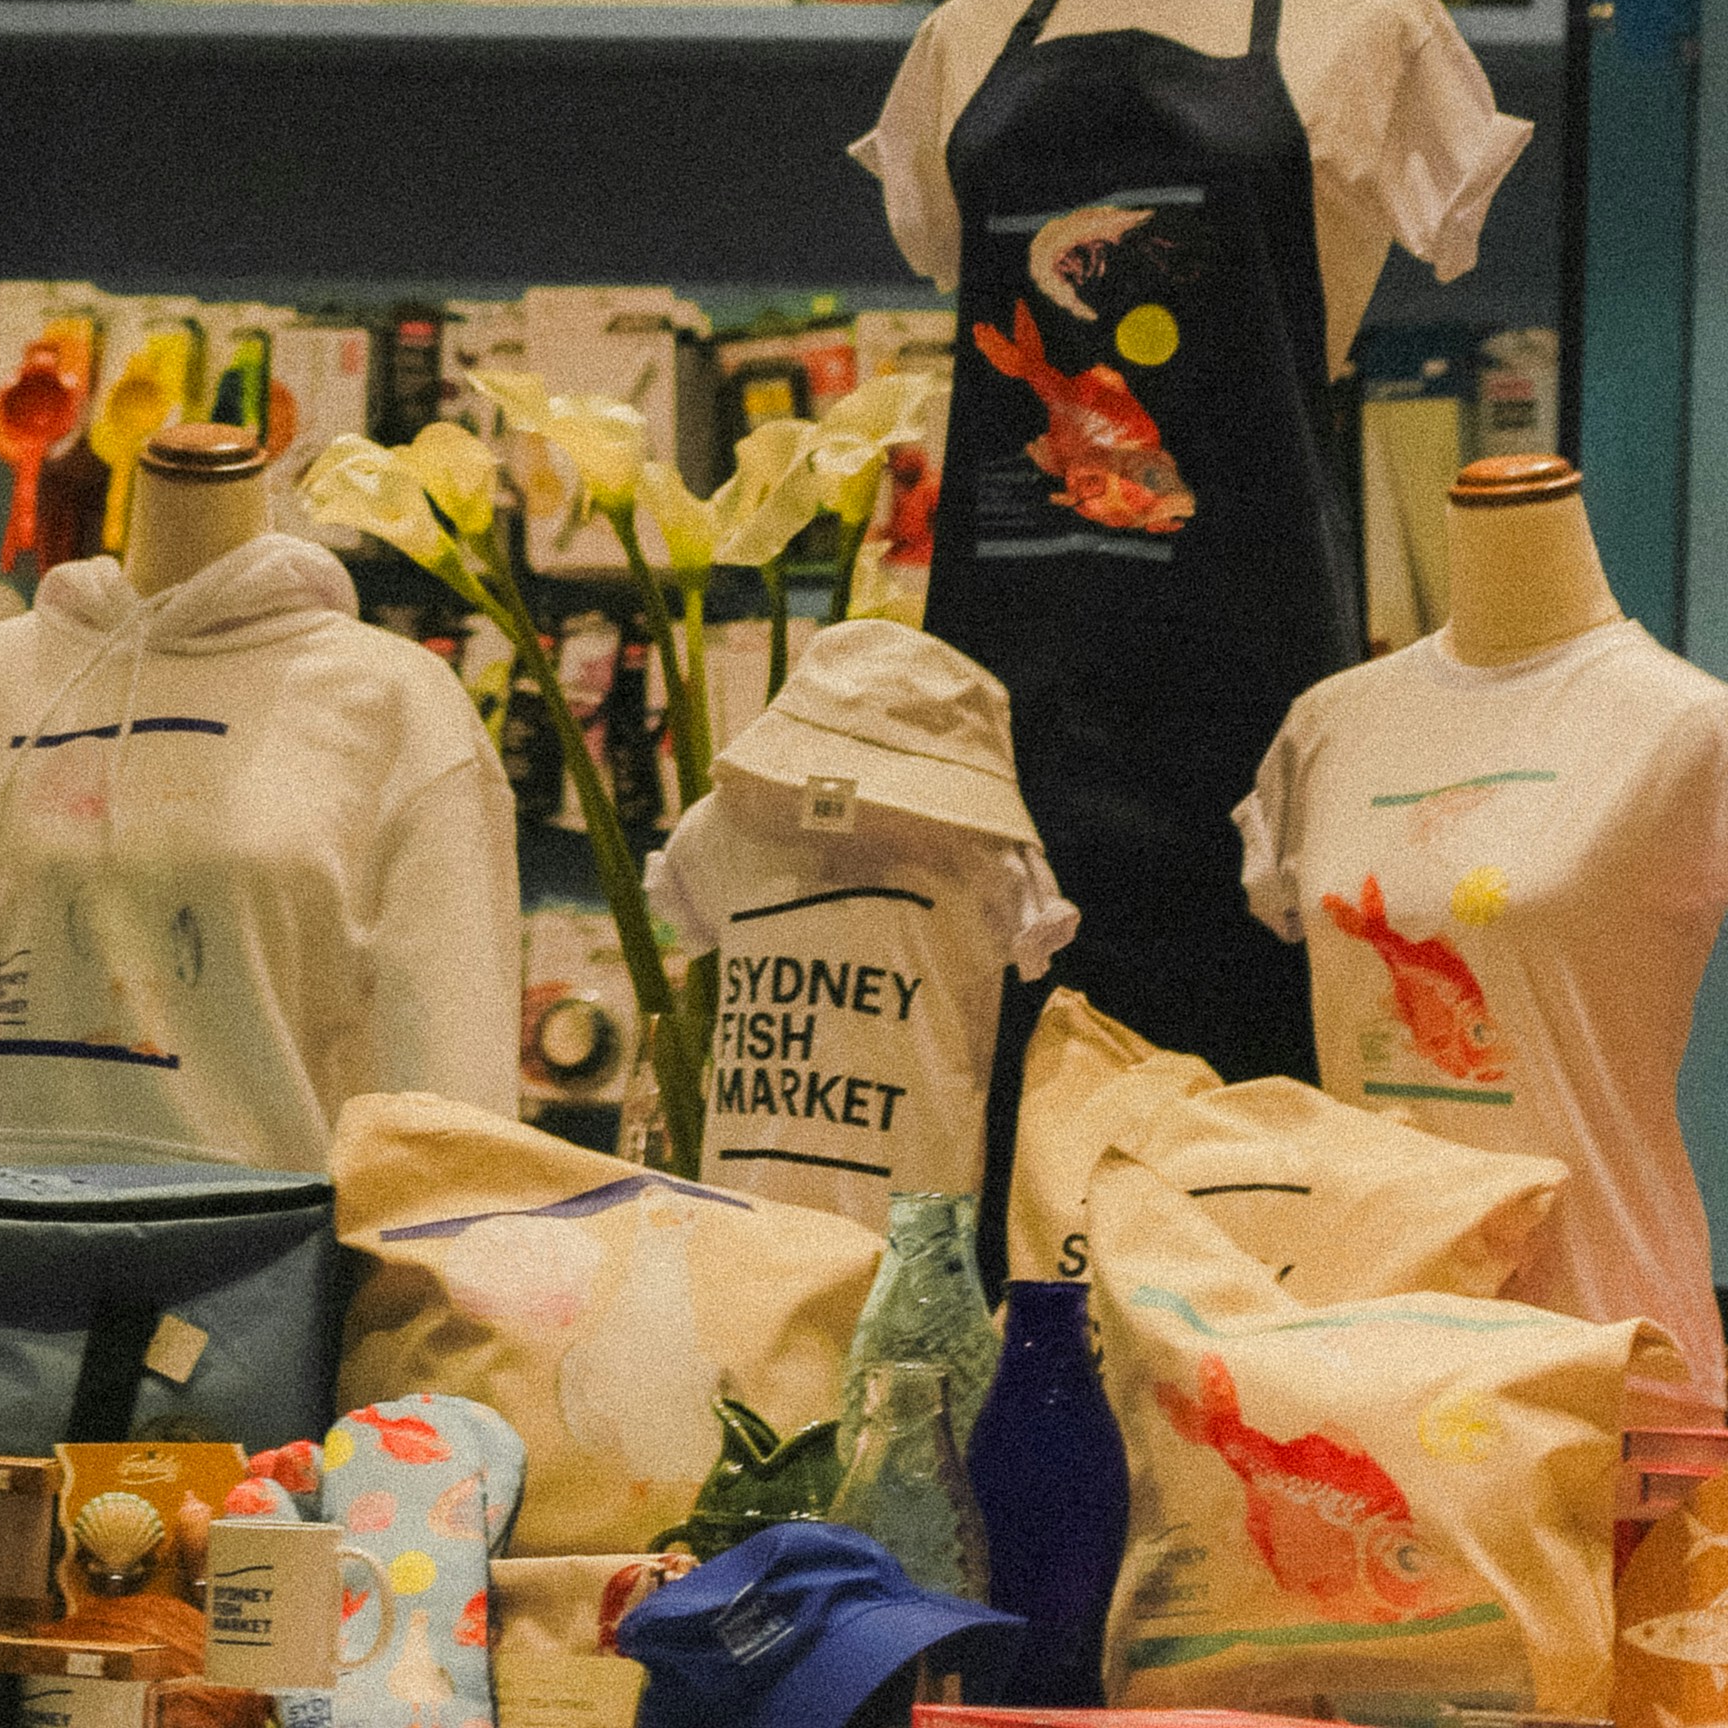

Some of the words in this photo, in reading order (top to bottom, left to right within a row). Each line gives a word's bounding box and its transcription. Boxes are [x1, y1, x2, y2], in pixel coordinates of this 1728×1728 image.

[725, 955, 923, 1021] SYDNEY
[722, 1012, 815, 1062] FISH
[716, 1066, 907, 1132] MARKET
